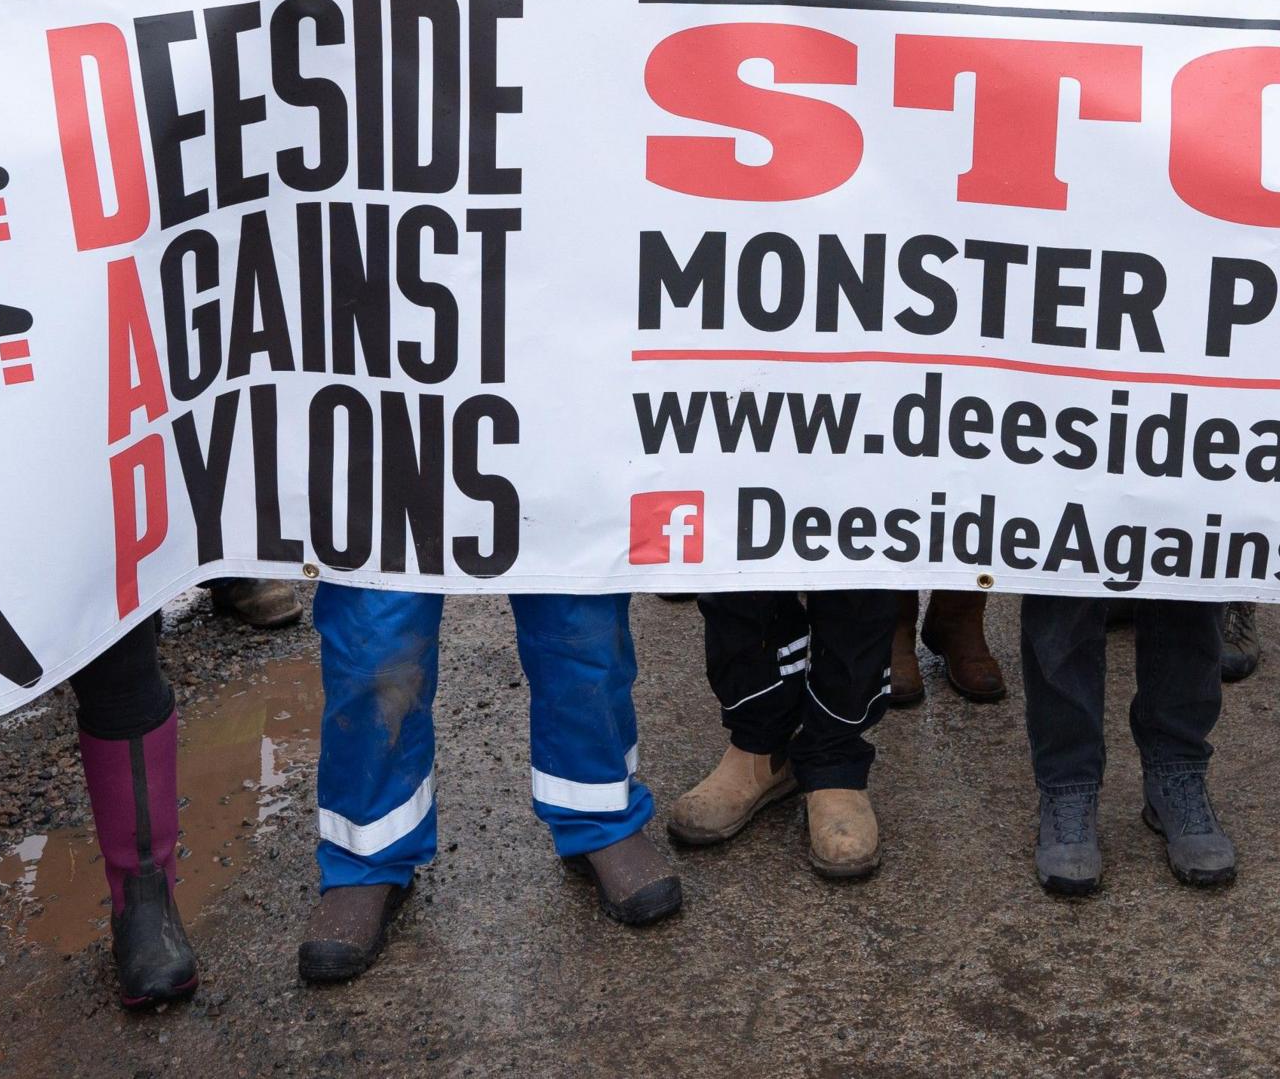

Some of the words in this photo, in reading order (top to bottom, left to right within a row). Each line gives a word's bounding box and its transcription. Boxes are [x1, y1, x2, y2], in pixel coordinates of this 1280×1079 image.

[107, 201, 522, 446] AGAINST
[637, 230, 1167, 353] MONSTER
[109, 383, 520, 620] PYLONS
